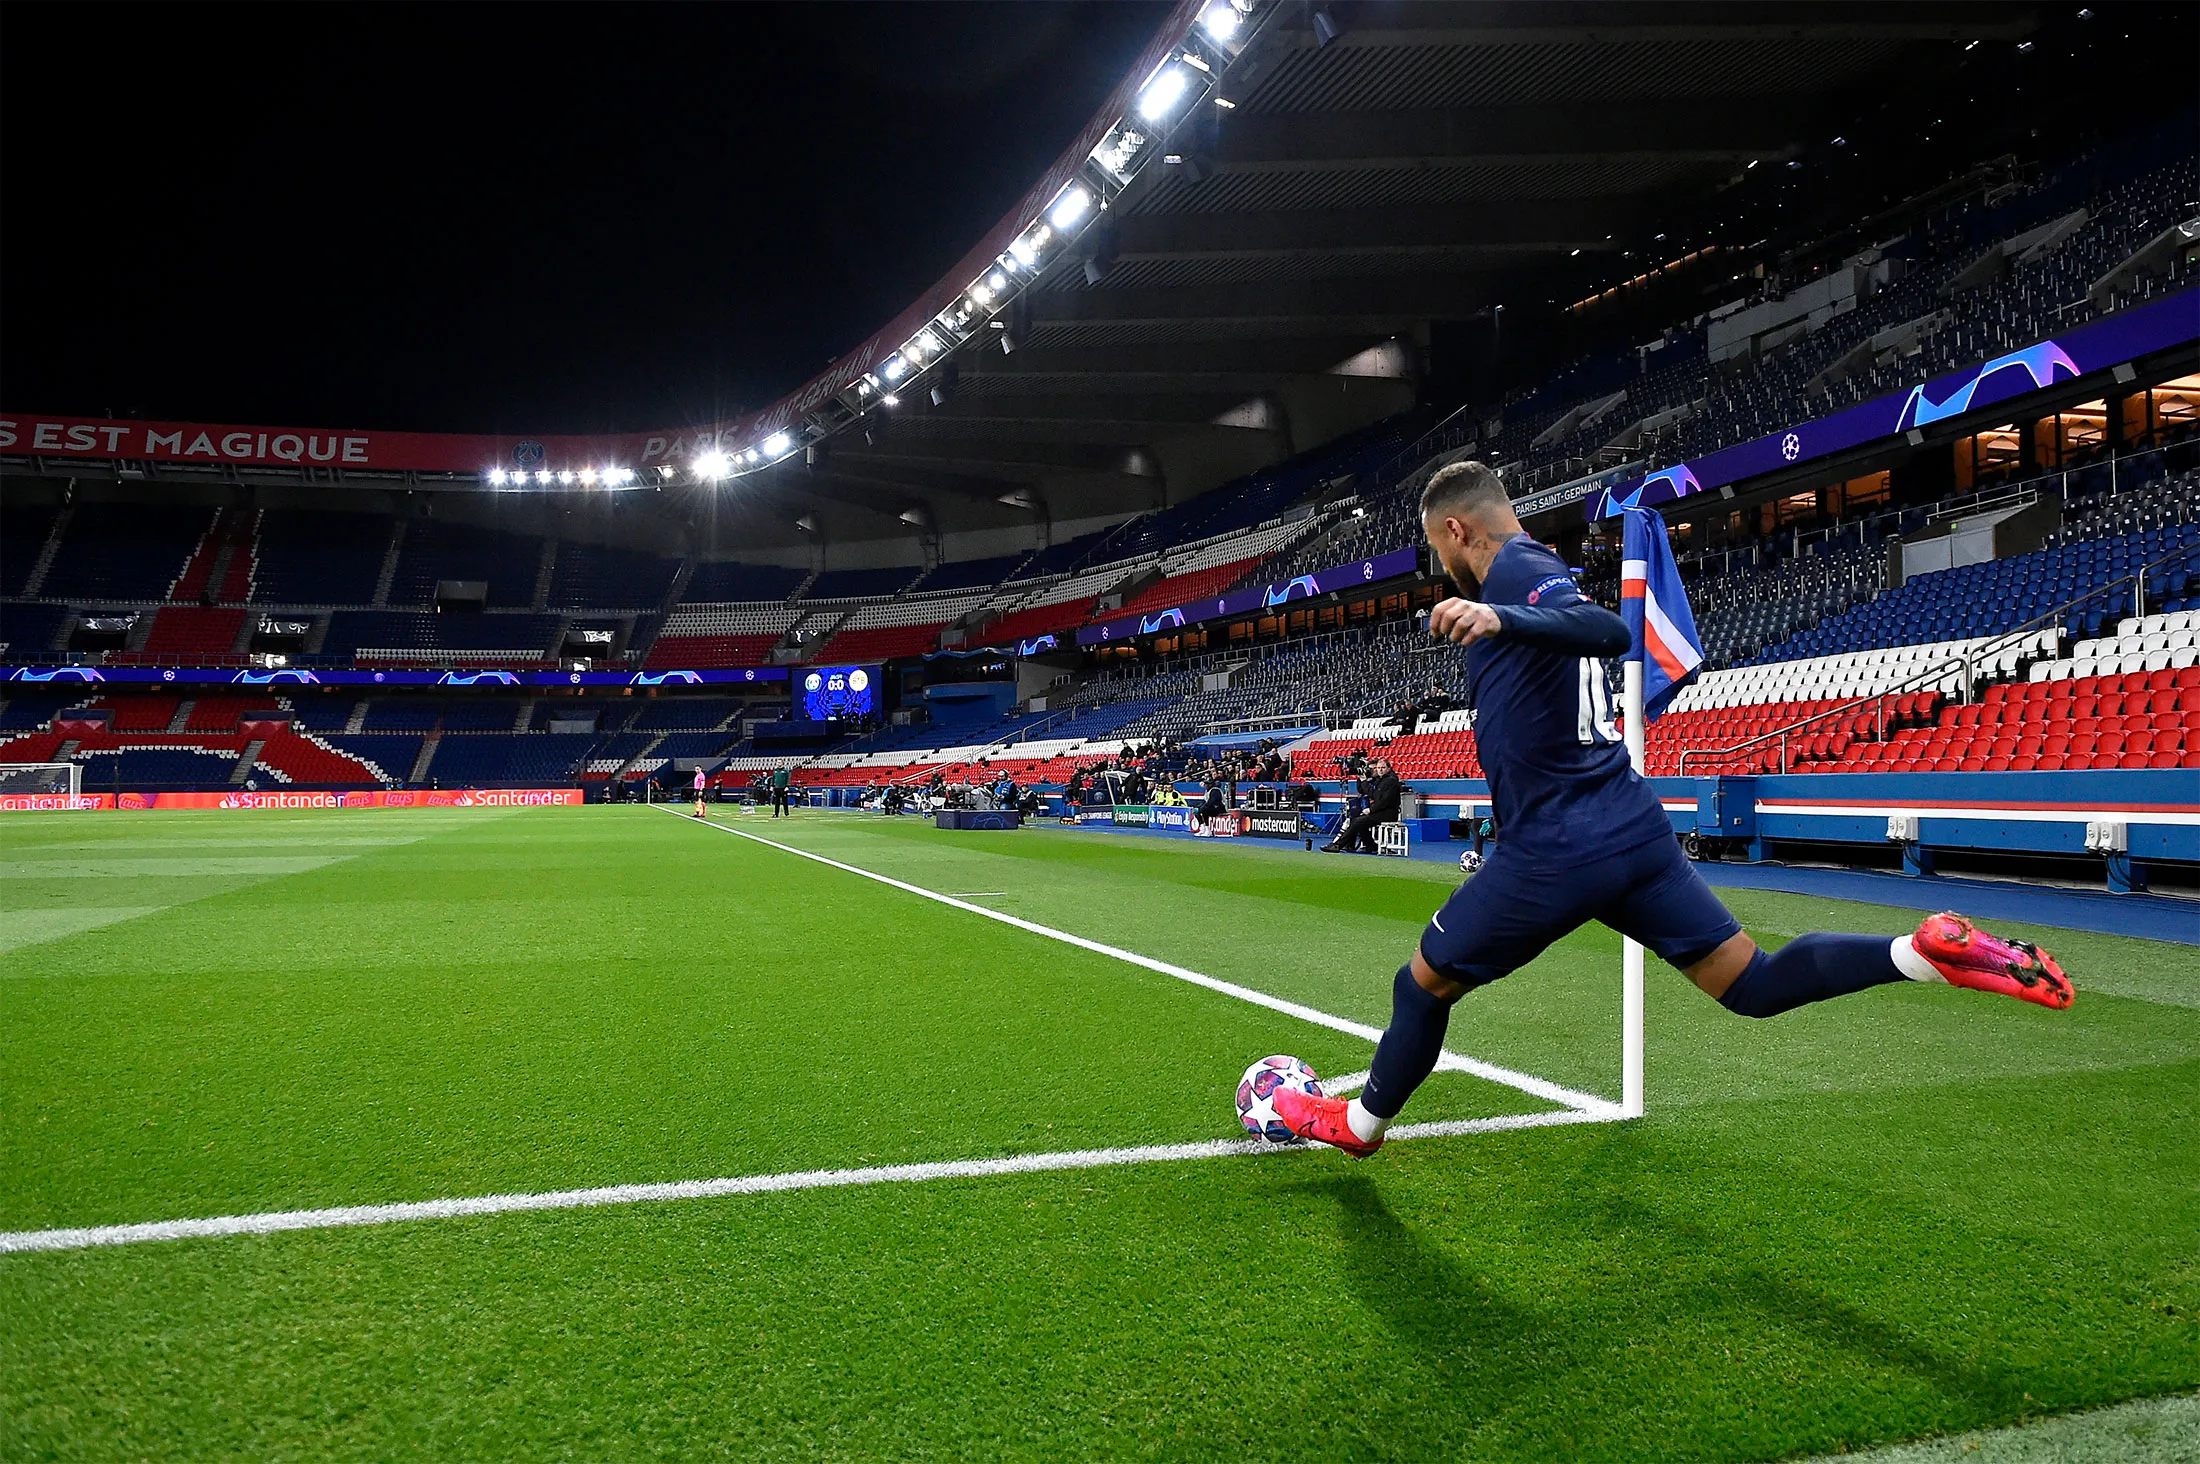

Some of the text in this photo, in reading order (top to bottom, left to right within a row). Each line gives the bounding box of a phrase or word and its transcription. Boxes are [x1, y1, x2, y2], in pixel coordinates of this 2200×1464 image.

[33, 423, 130, 452] EST
[145, 429, 369, 462] MAGIQUE
[1515, 480, 1602, 516] PARIS SAINT-GERMAIN
[828, 679, 844, 691] 0:0
[242, 792, 344, 809] Santander
[475, 790, 571, 806] Santander
[1156, 810, 1182, 829] PlayStation
[1252, 816, 1297, 833] mastercard
